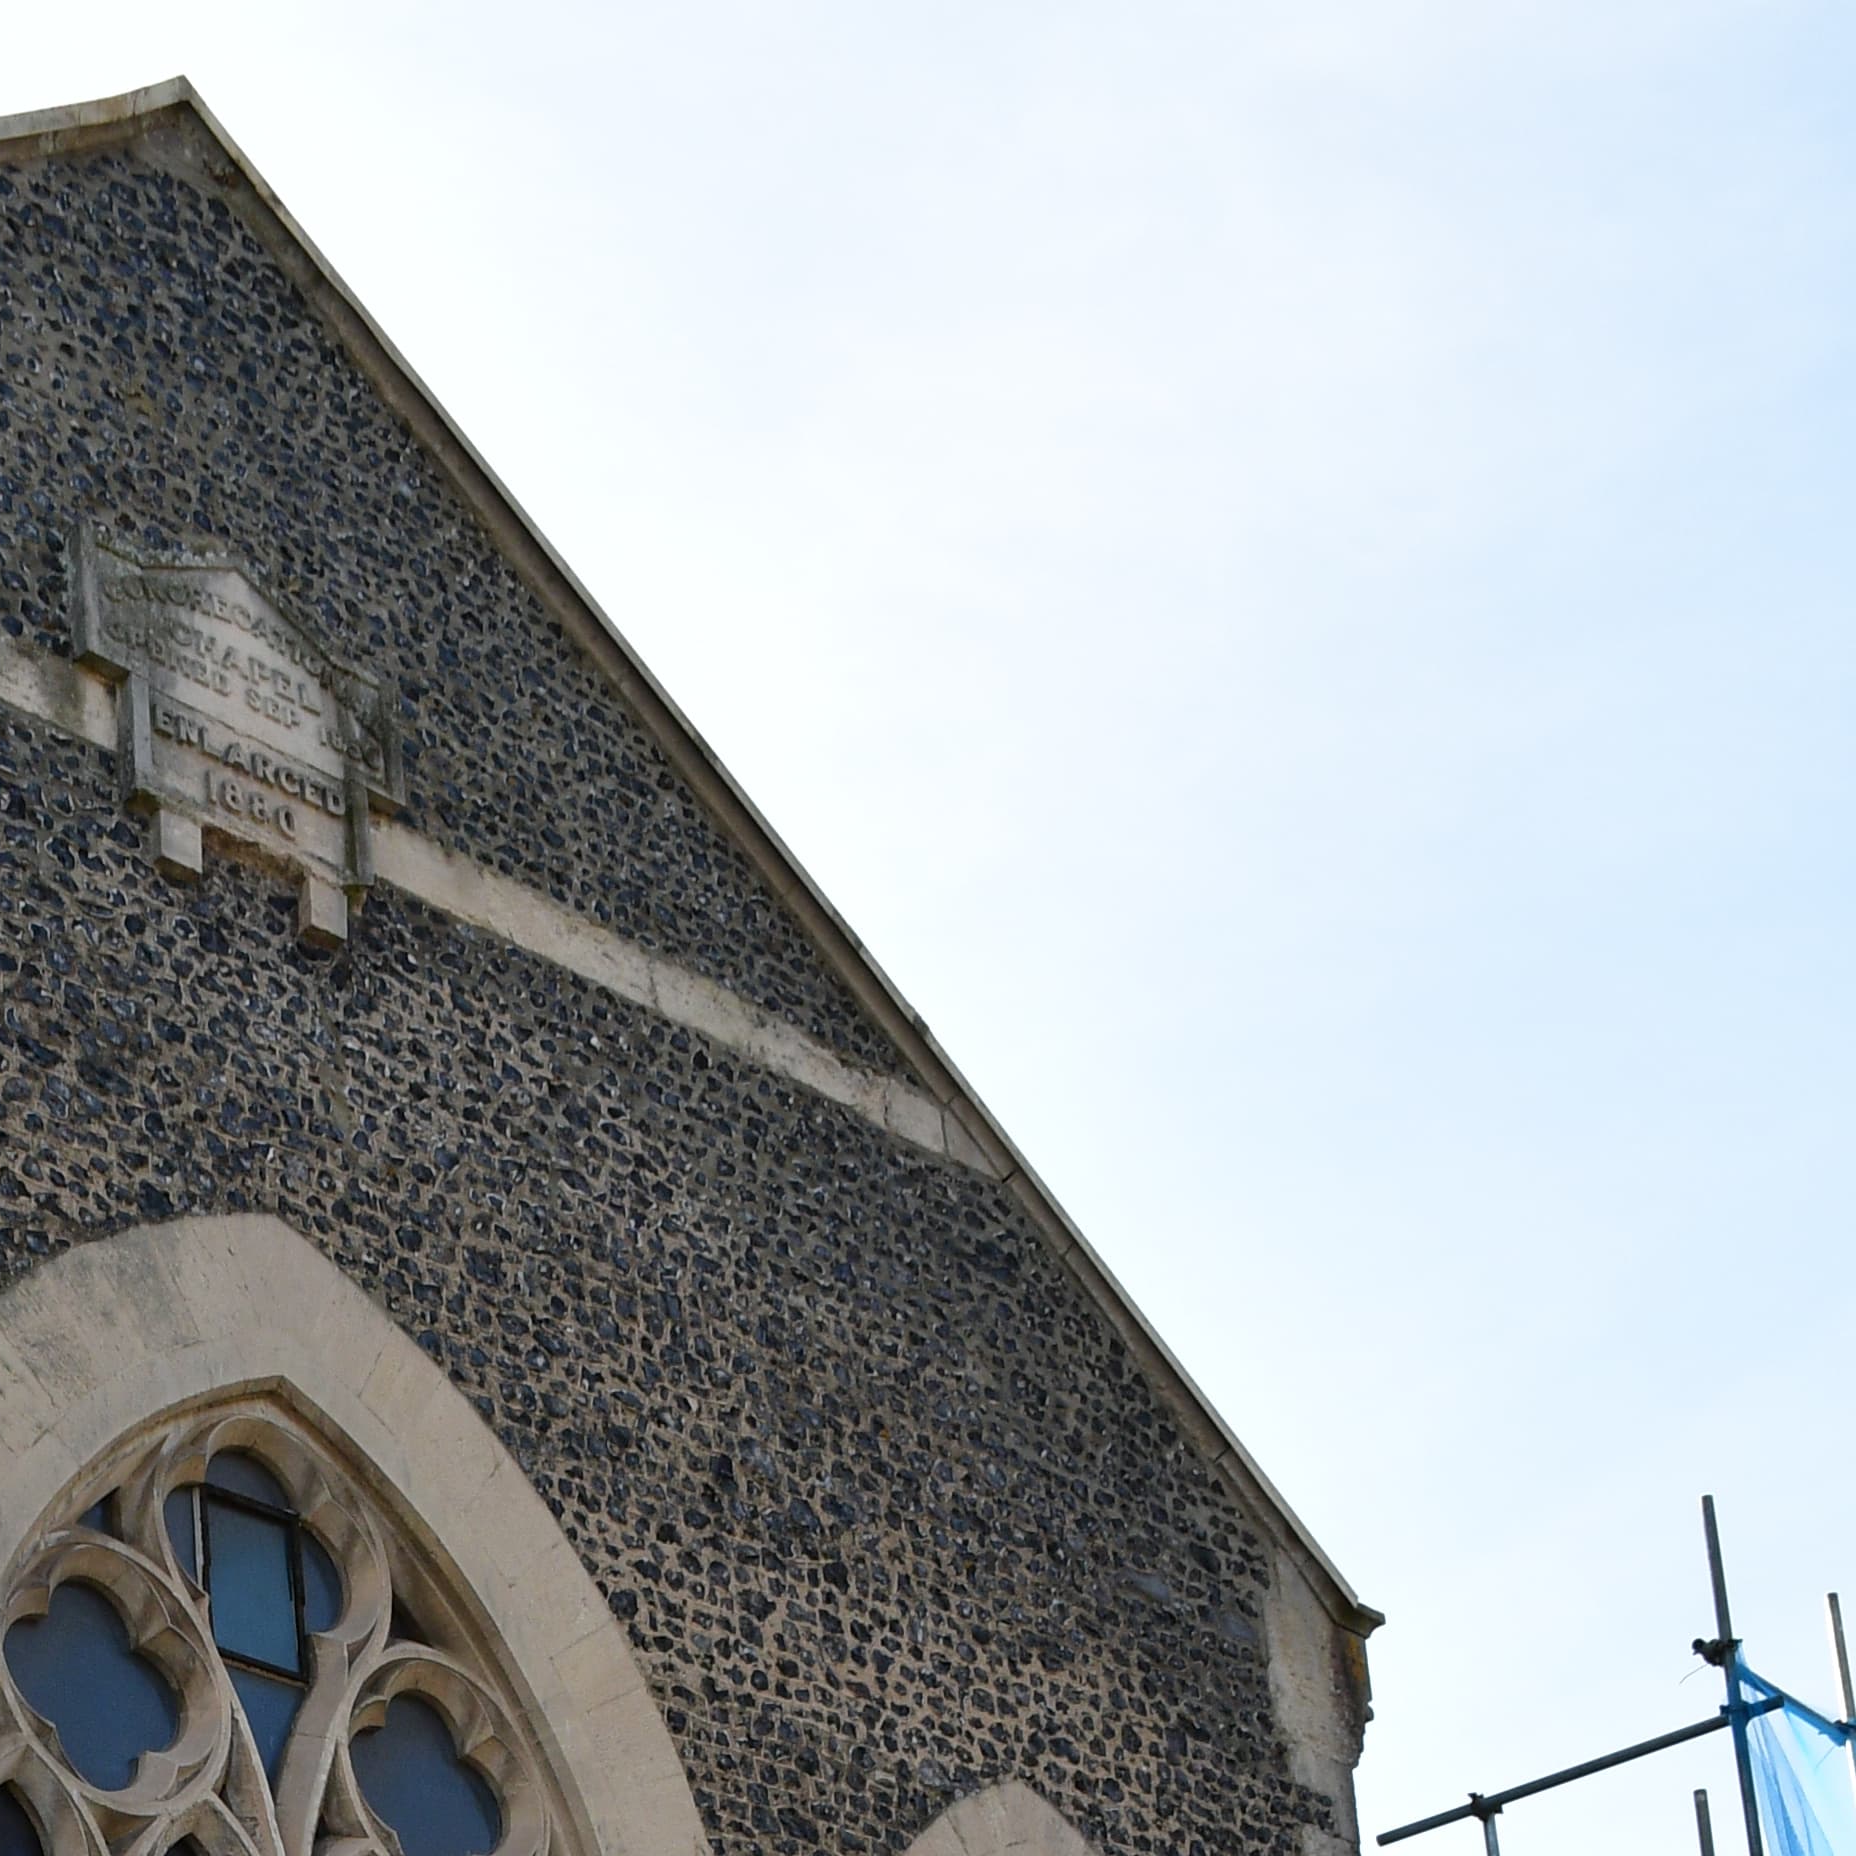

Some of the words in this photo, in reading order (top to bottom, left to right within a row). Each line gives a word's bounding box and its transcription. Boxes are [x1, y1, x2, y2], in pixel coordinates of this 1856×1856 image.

[170, 620, 320, 717] CHAPEL
[153, 703, 346, 817] ENLARGED
[206, 771, 297, 841] 1880
